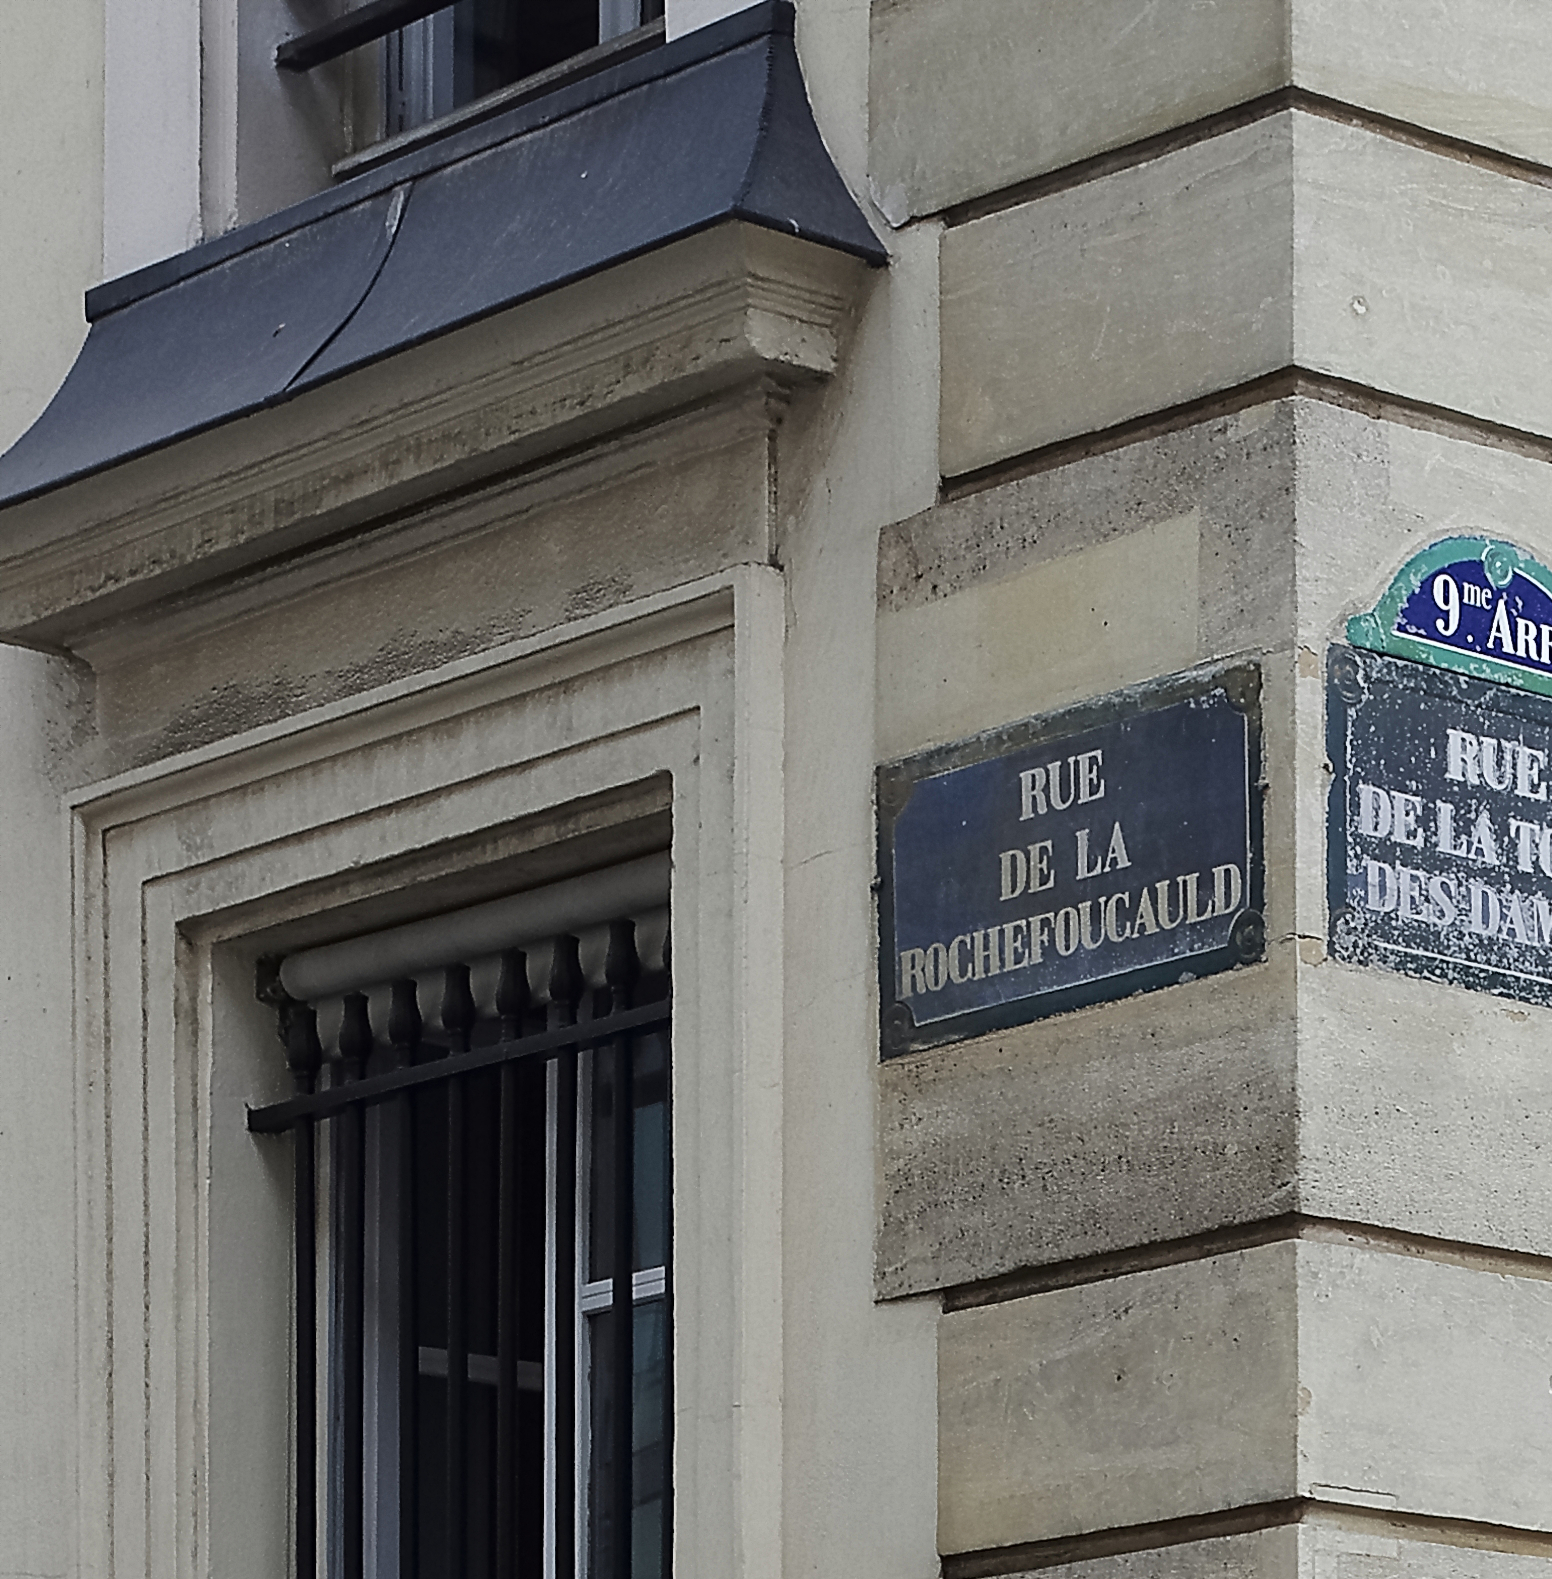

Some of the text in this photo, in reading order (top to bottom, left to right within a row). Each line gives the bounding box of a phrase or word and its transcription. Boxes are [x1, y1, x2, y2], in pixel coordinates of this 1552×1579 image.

[1019, 750, 1105, 821] RUE
[1445, 728, 1548, 801] RUE
[999, 821, 1132, 901] DE LA
[1357, 783, 1424, 848] DE
[1437, 803, 1500, 866] LA
[1366, 860, 1457, 926] DES
[899, 863, 1242, 1000] ROCHEFOUCAULD
